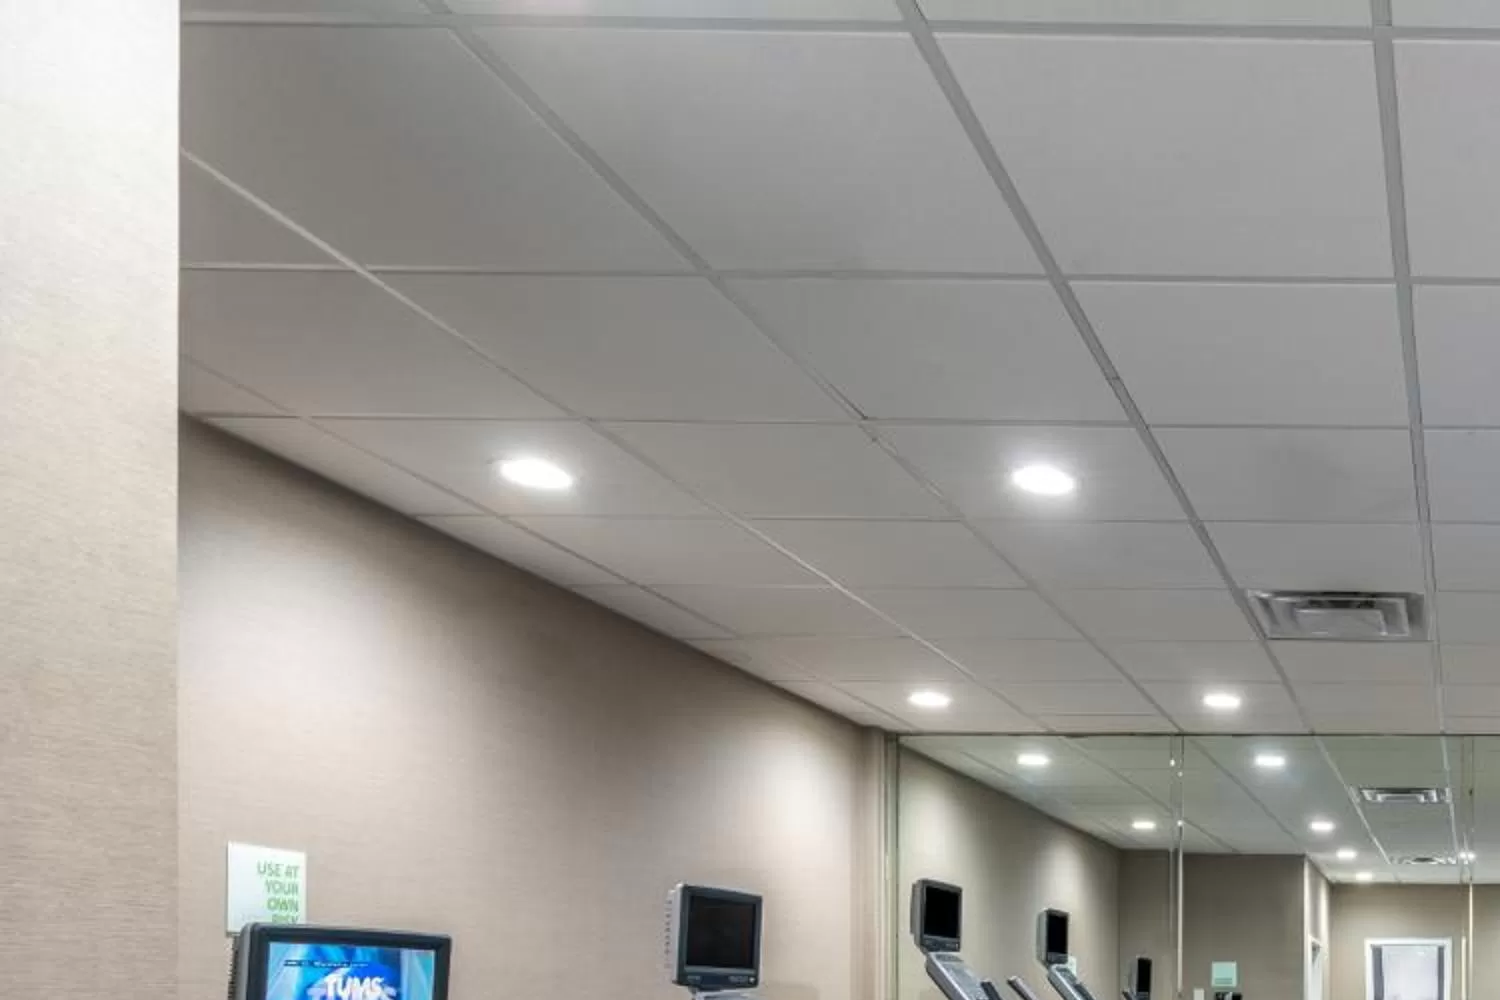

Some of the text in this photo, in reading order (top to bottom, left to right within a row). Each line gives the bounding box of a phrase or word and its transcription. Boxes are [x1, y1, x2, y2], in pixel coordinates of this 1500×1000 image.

[257, 860, 300, 880] USE AT
[265, 879, 299, 896] YOUR
[267, 896, 299, 913] OWN
